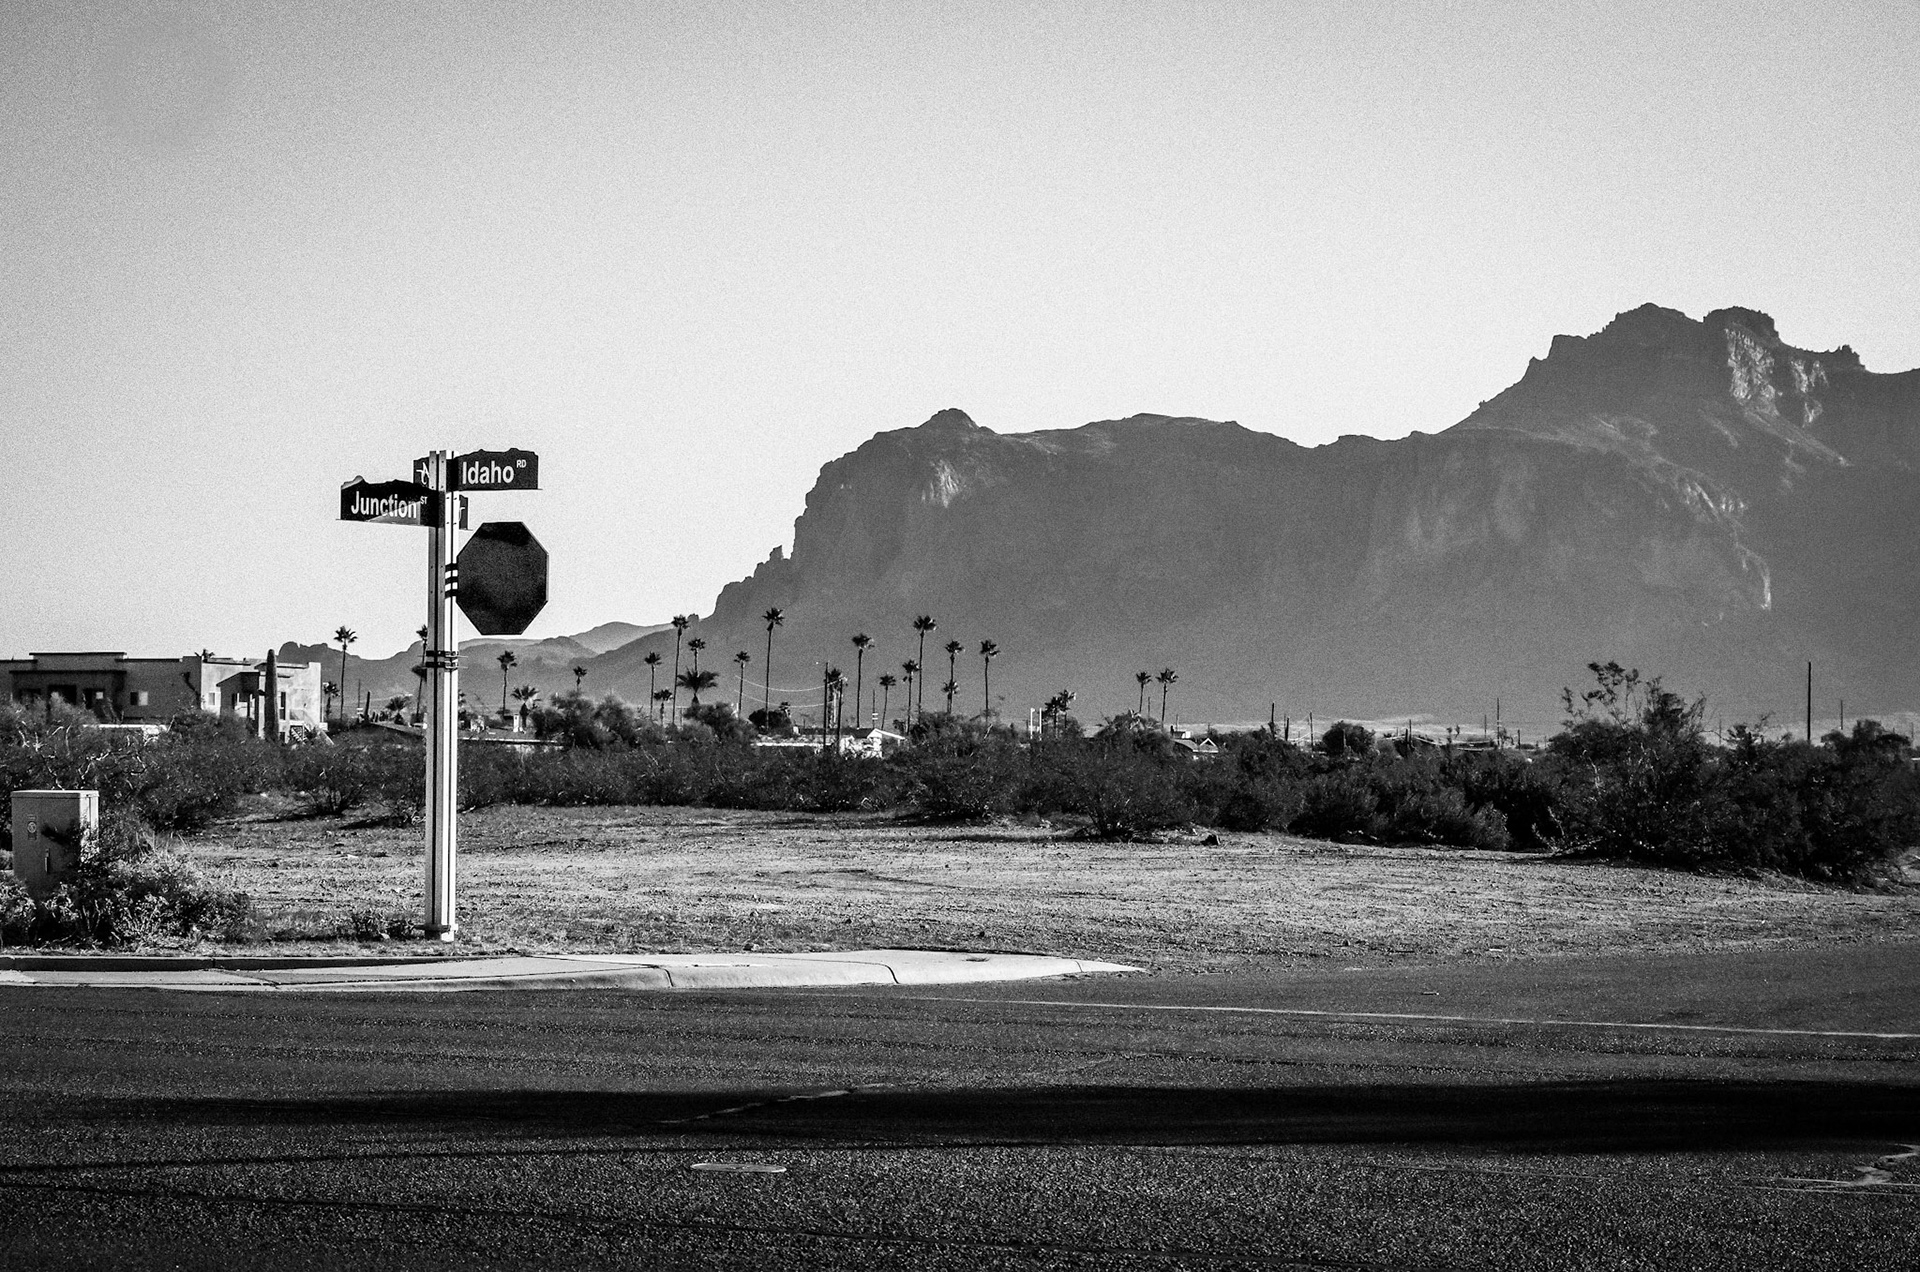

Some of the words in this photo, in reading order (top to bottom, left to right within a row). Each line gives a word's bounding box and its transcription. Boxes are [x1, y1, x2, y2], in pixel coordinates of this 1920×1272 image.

[462, 461, 515, 484] Idaho
[516, 459, 527, 468] RD
[350, 491, 417, 518] Junction
[420, 496, 428, 504] ST
